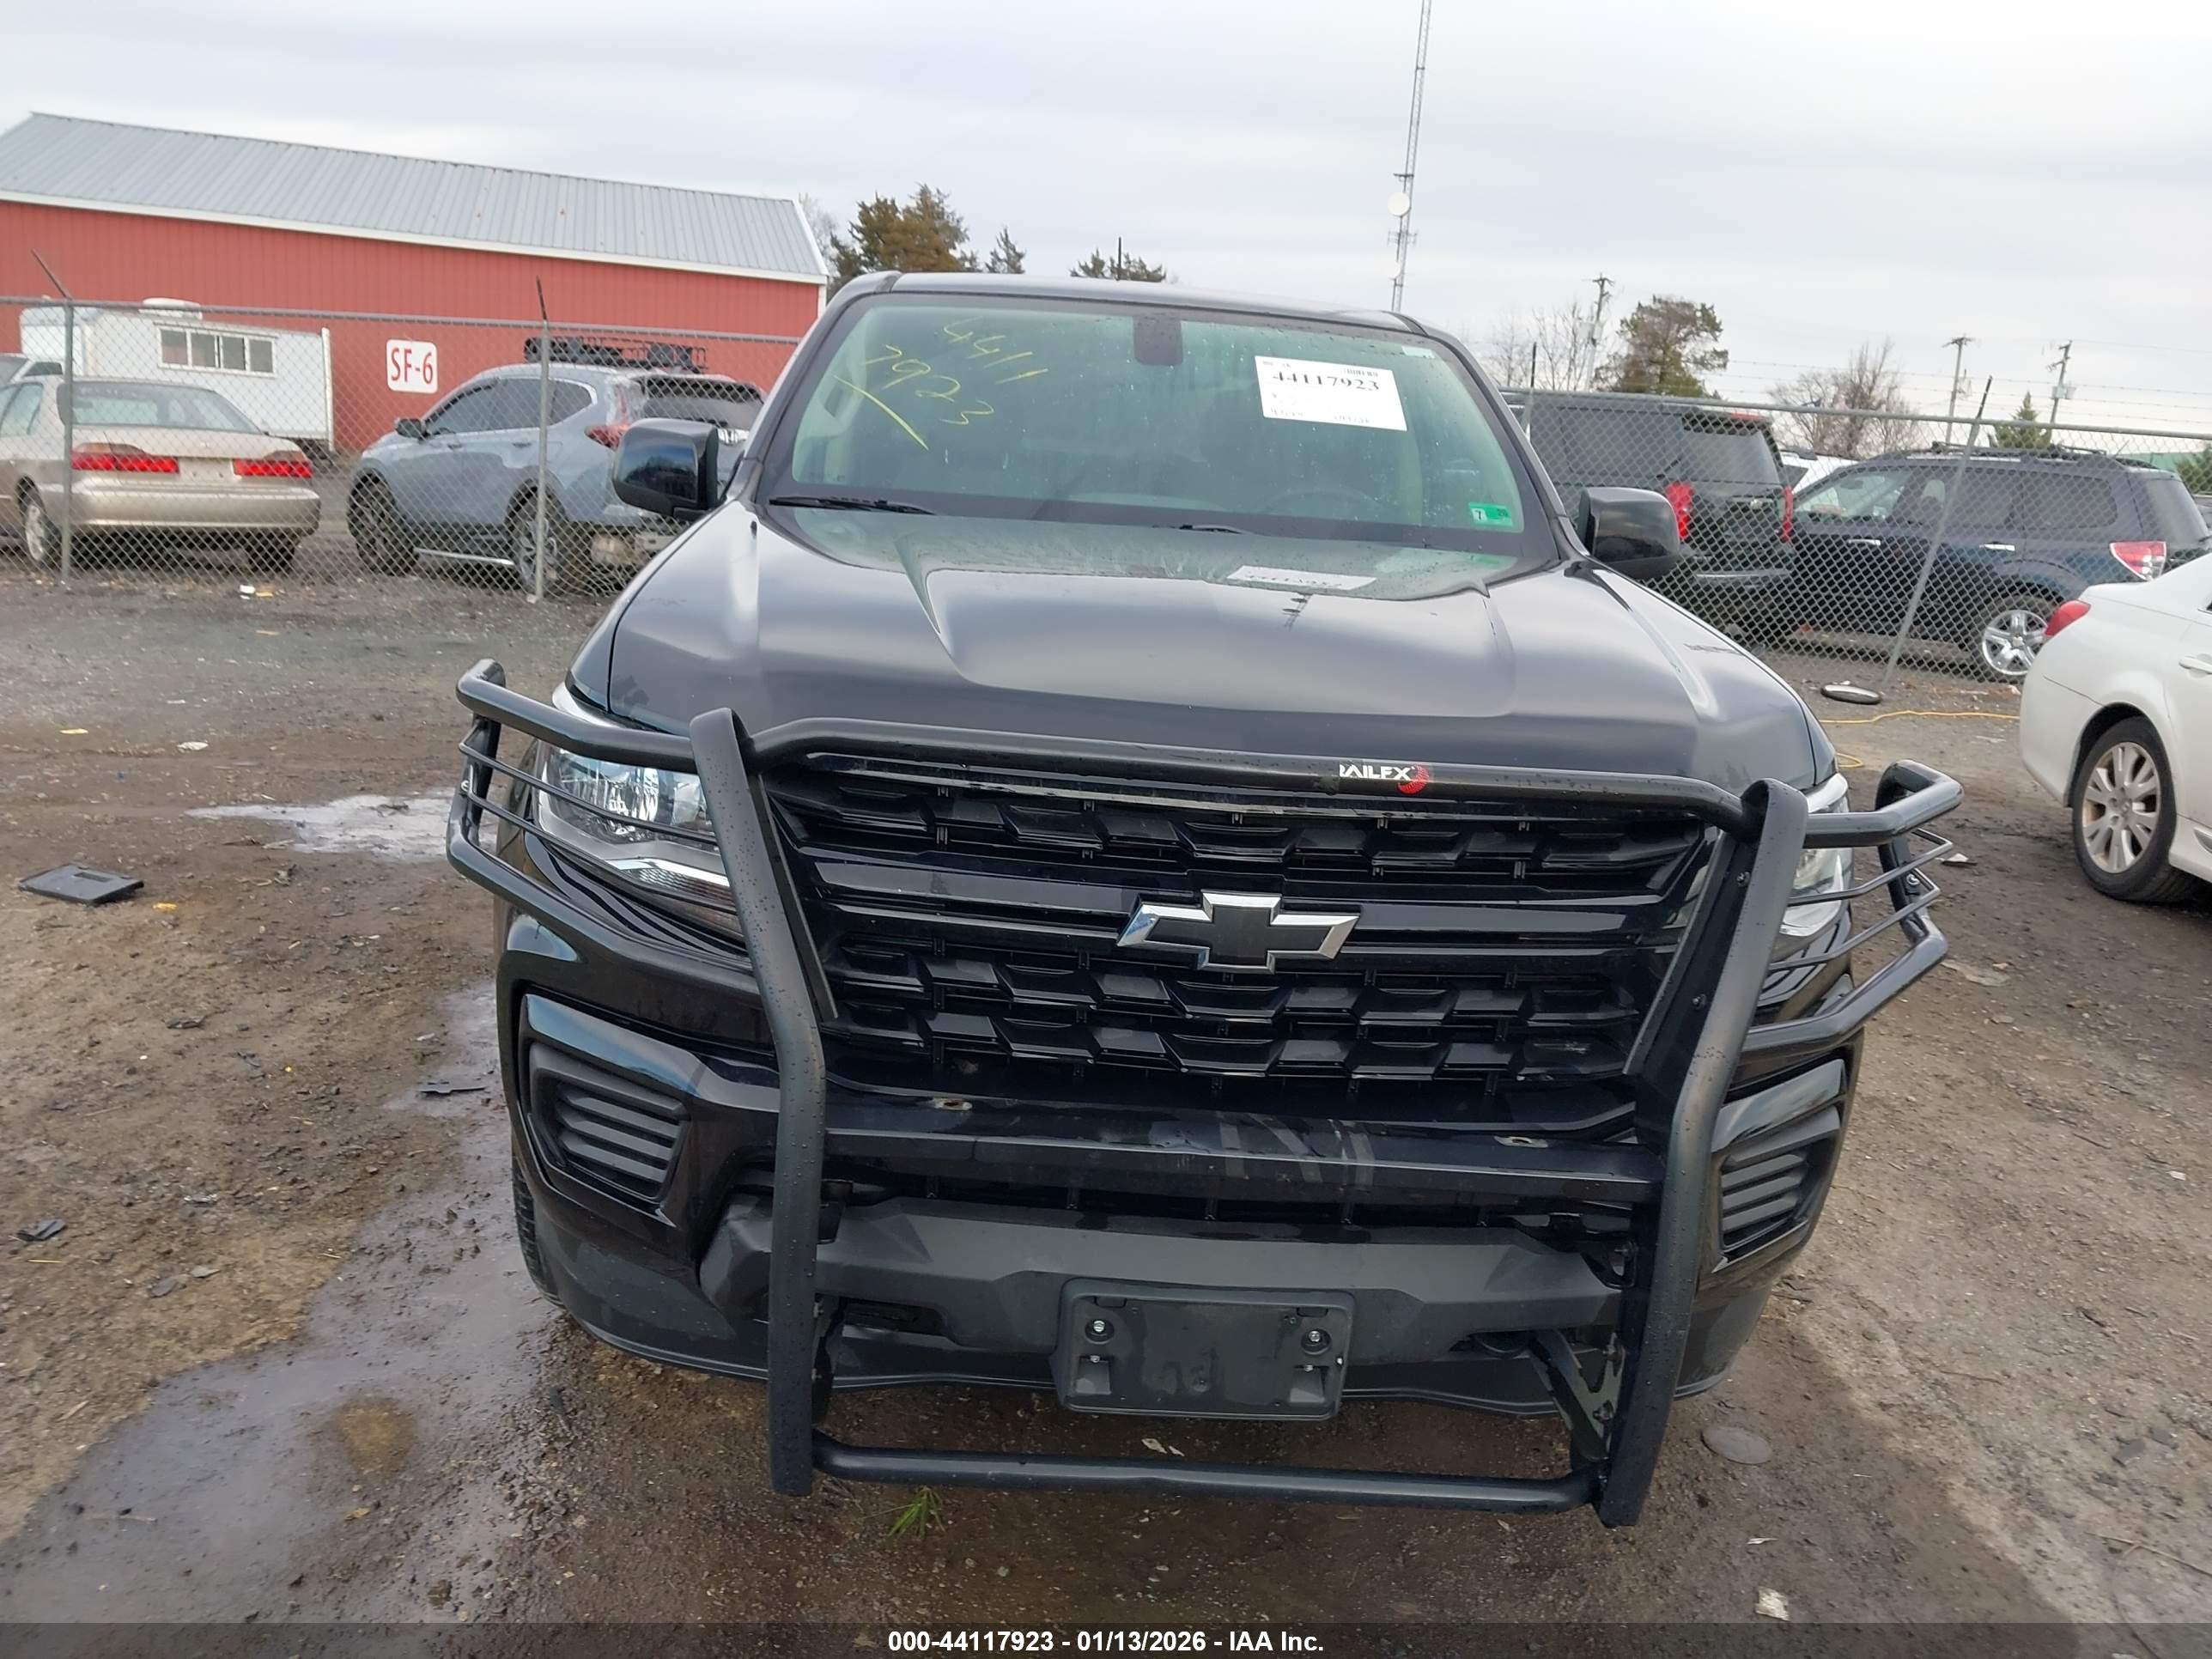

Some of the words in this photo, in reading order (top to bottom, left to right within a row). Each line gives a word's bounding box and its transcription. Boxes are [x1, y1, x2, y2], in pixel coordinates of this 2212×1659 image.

[391, 346, 434, 385] SF-6
[944, 315, 1049, 385] 4411
[1272, 370, 1380, 392] 44117923
